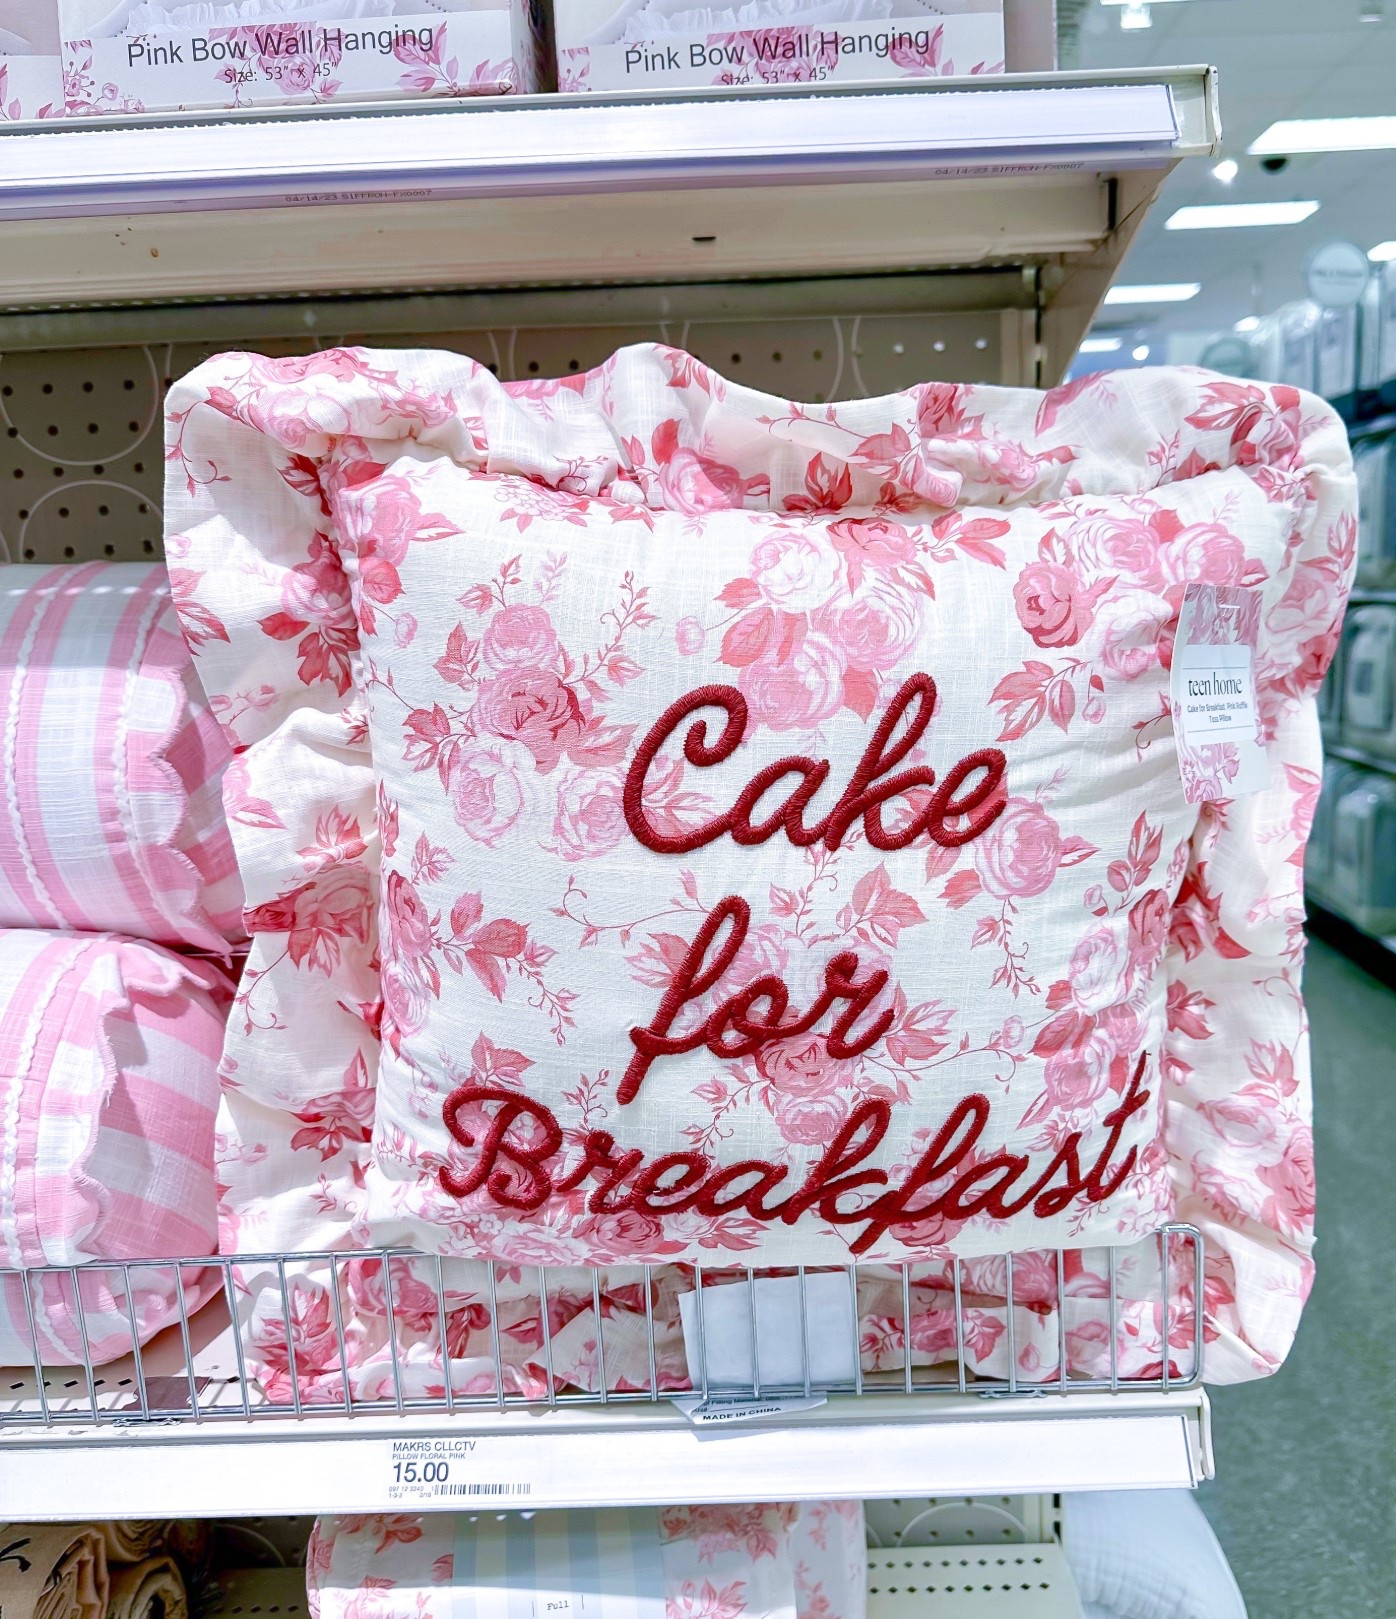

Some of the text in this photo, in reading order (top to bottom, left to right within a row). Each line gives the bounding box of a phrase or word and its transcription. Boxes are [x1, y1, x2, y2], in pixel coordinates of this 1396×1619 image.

[127, 24, 434, 68] Pink Bow Wall Hanging
[625, 27, 930, 74] Pink Bow Wall Hanging
[224, 61, 338, 84] Size: 53" x 45"
[793, 72, 802, 82] x
[809, 65, 834, 81] 45"
[1188, 671, 1242, 696] teen home
[623, 673, 1007, 855] Cake
[616, 895, 896, 1105] for
[438, 1050, 1151, 1255] Breakfast
[703, 1413, 733, 1421] MADE
[748, 1407, 782, 1415] CHINA
[392, 1452, 466, 1461] PILLOW FLORAL PINK
[393, 1440, 477, 1452] MAKRS CLLCTV
[393, 1461, 450, 1484] 15.00
